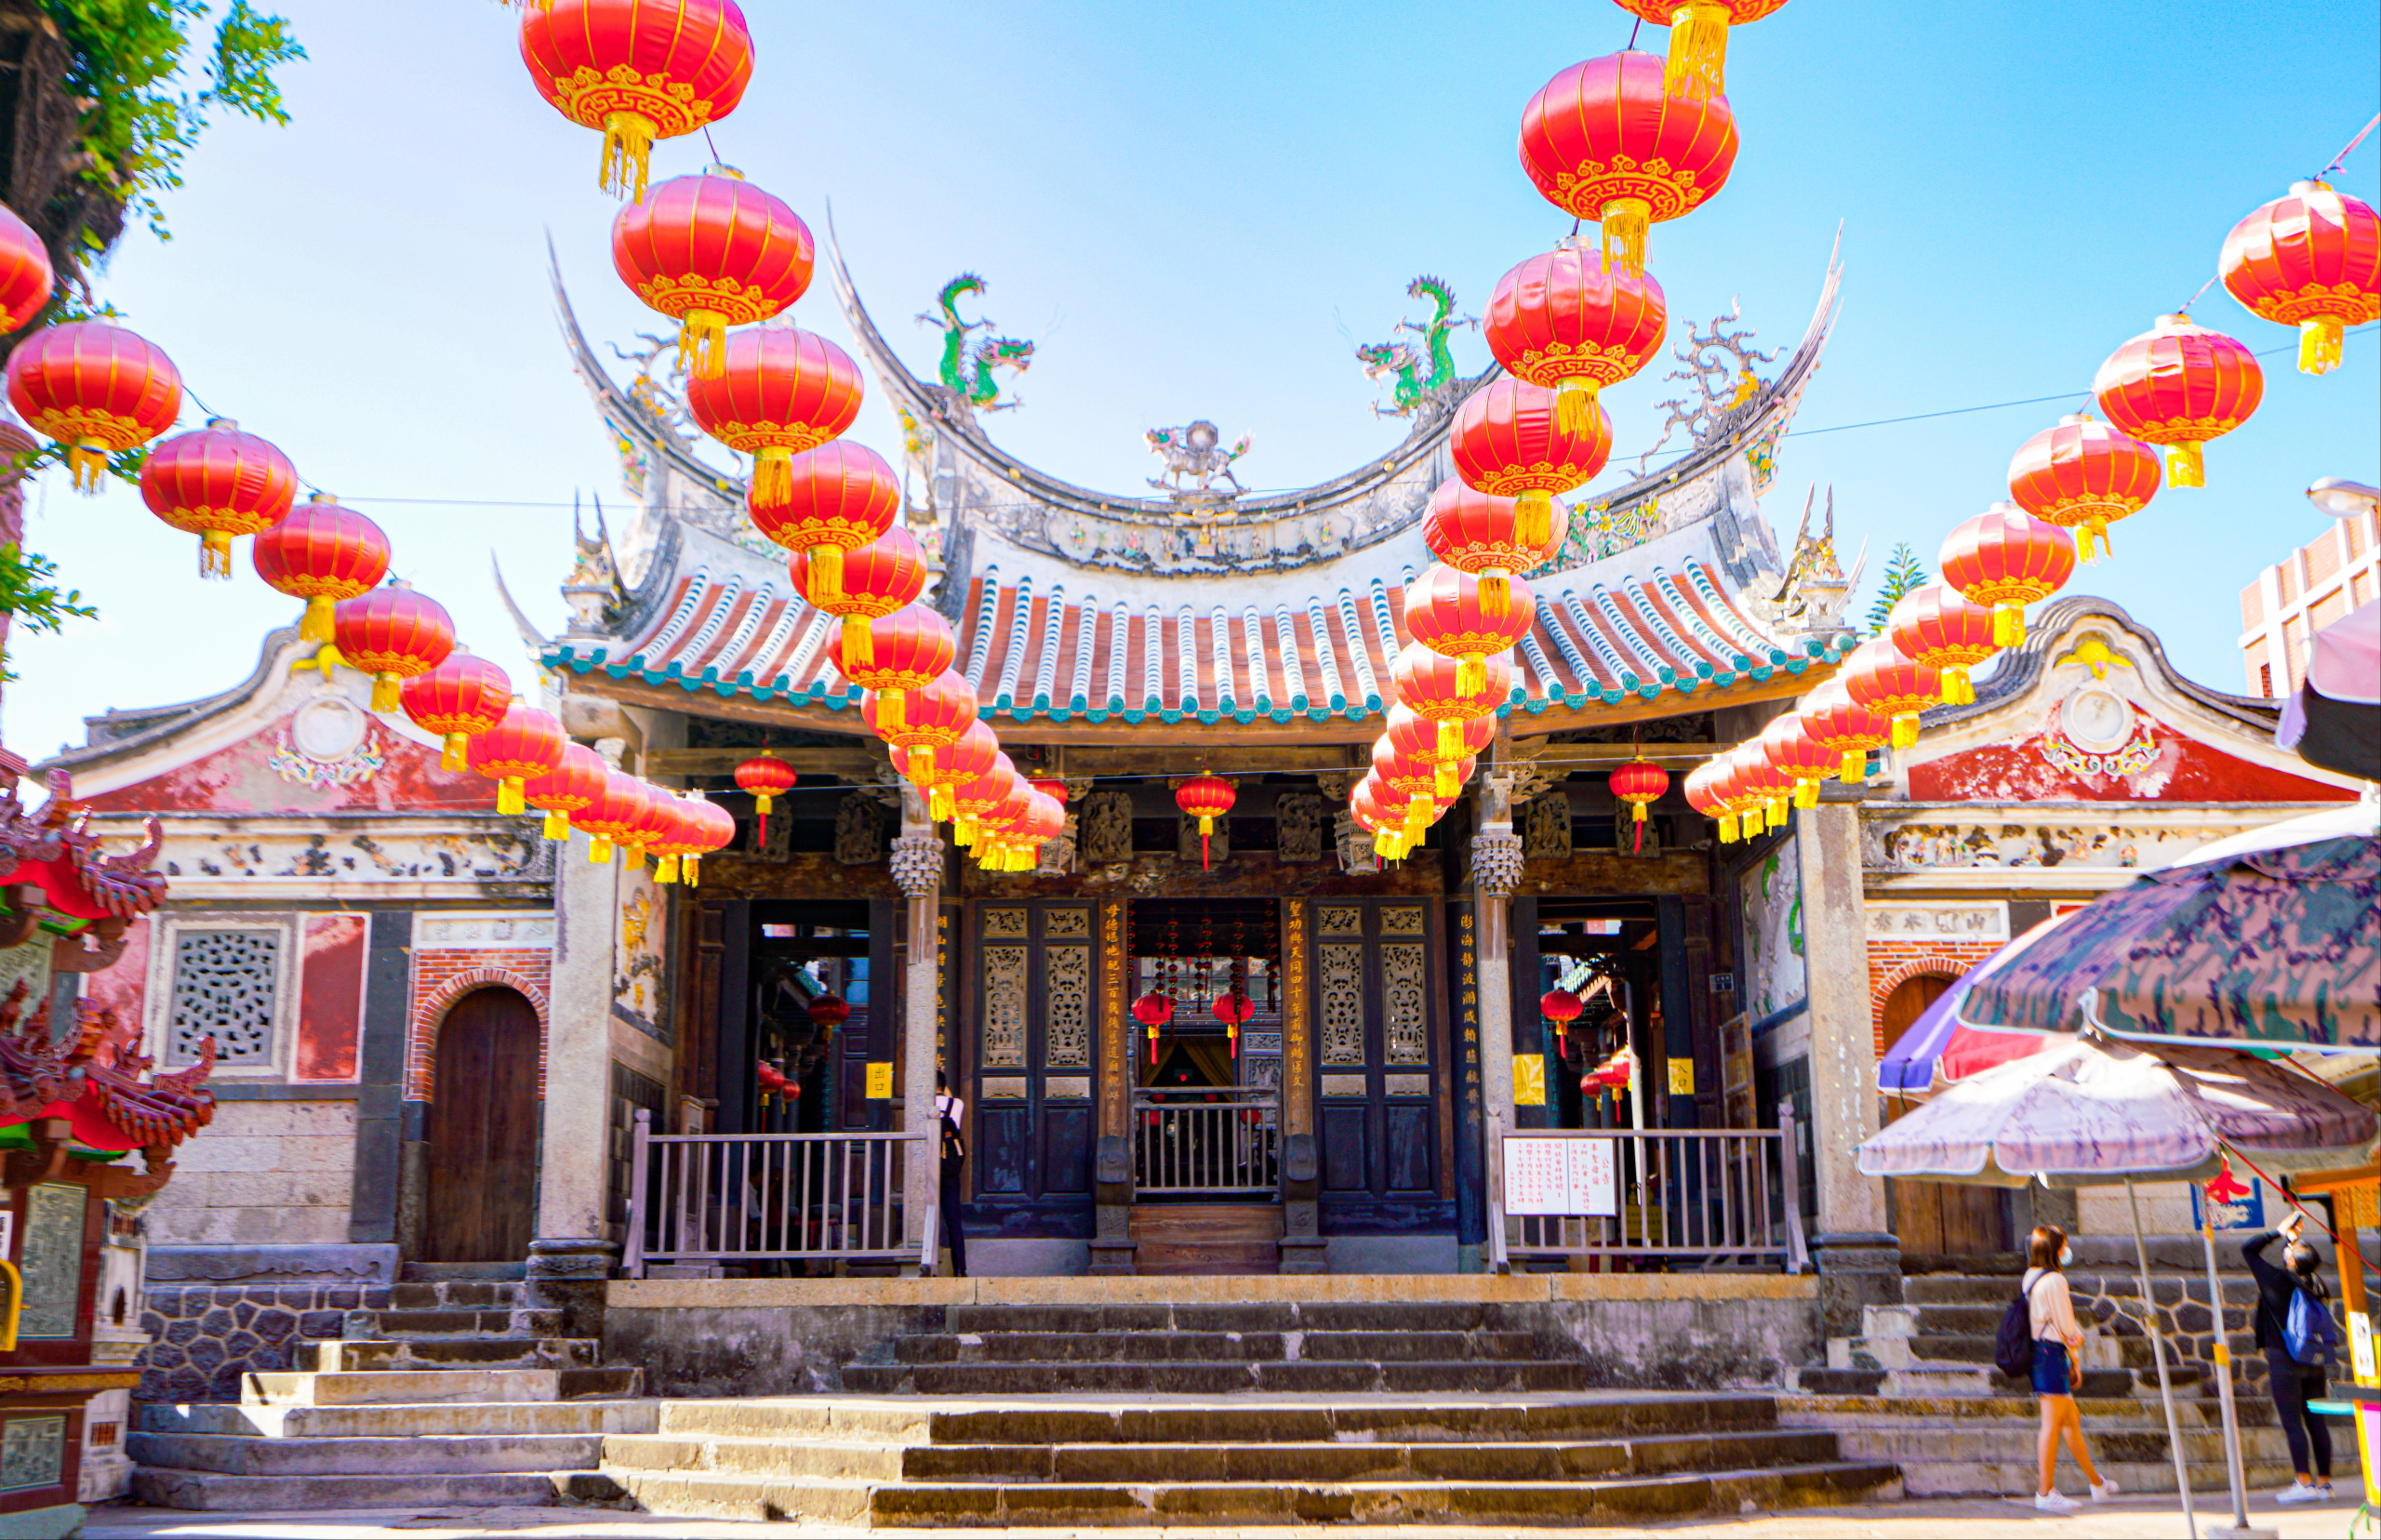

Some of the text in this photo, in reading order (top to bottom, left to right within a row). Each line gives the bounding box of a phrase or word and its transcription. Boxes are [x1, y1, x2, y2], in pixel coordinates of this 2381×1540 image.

[874, 1067, 885, 1091] 出口
[1677, 1064, 1688, 1087] 入口
[1602, 1156, 1611, 1186] 公告
